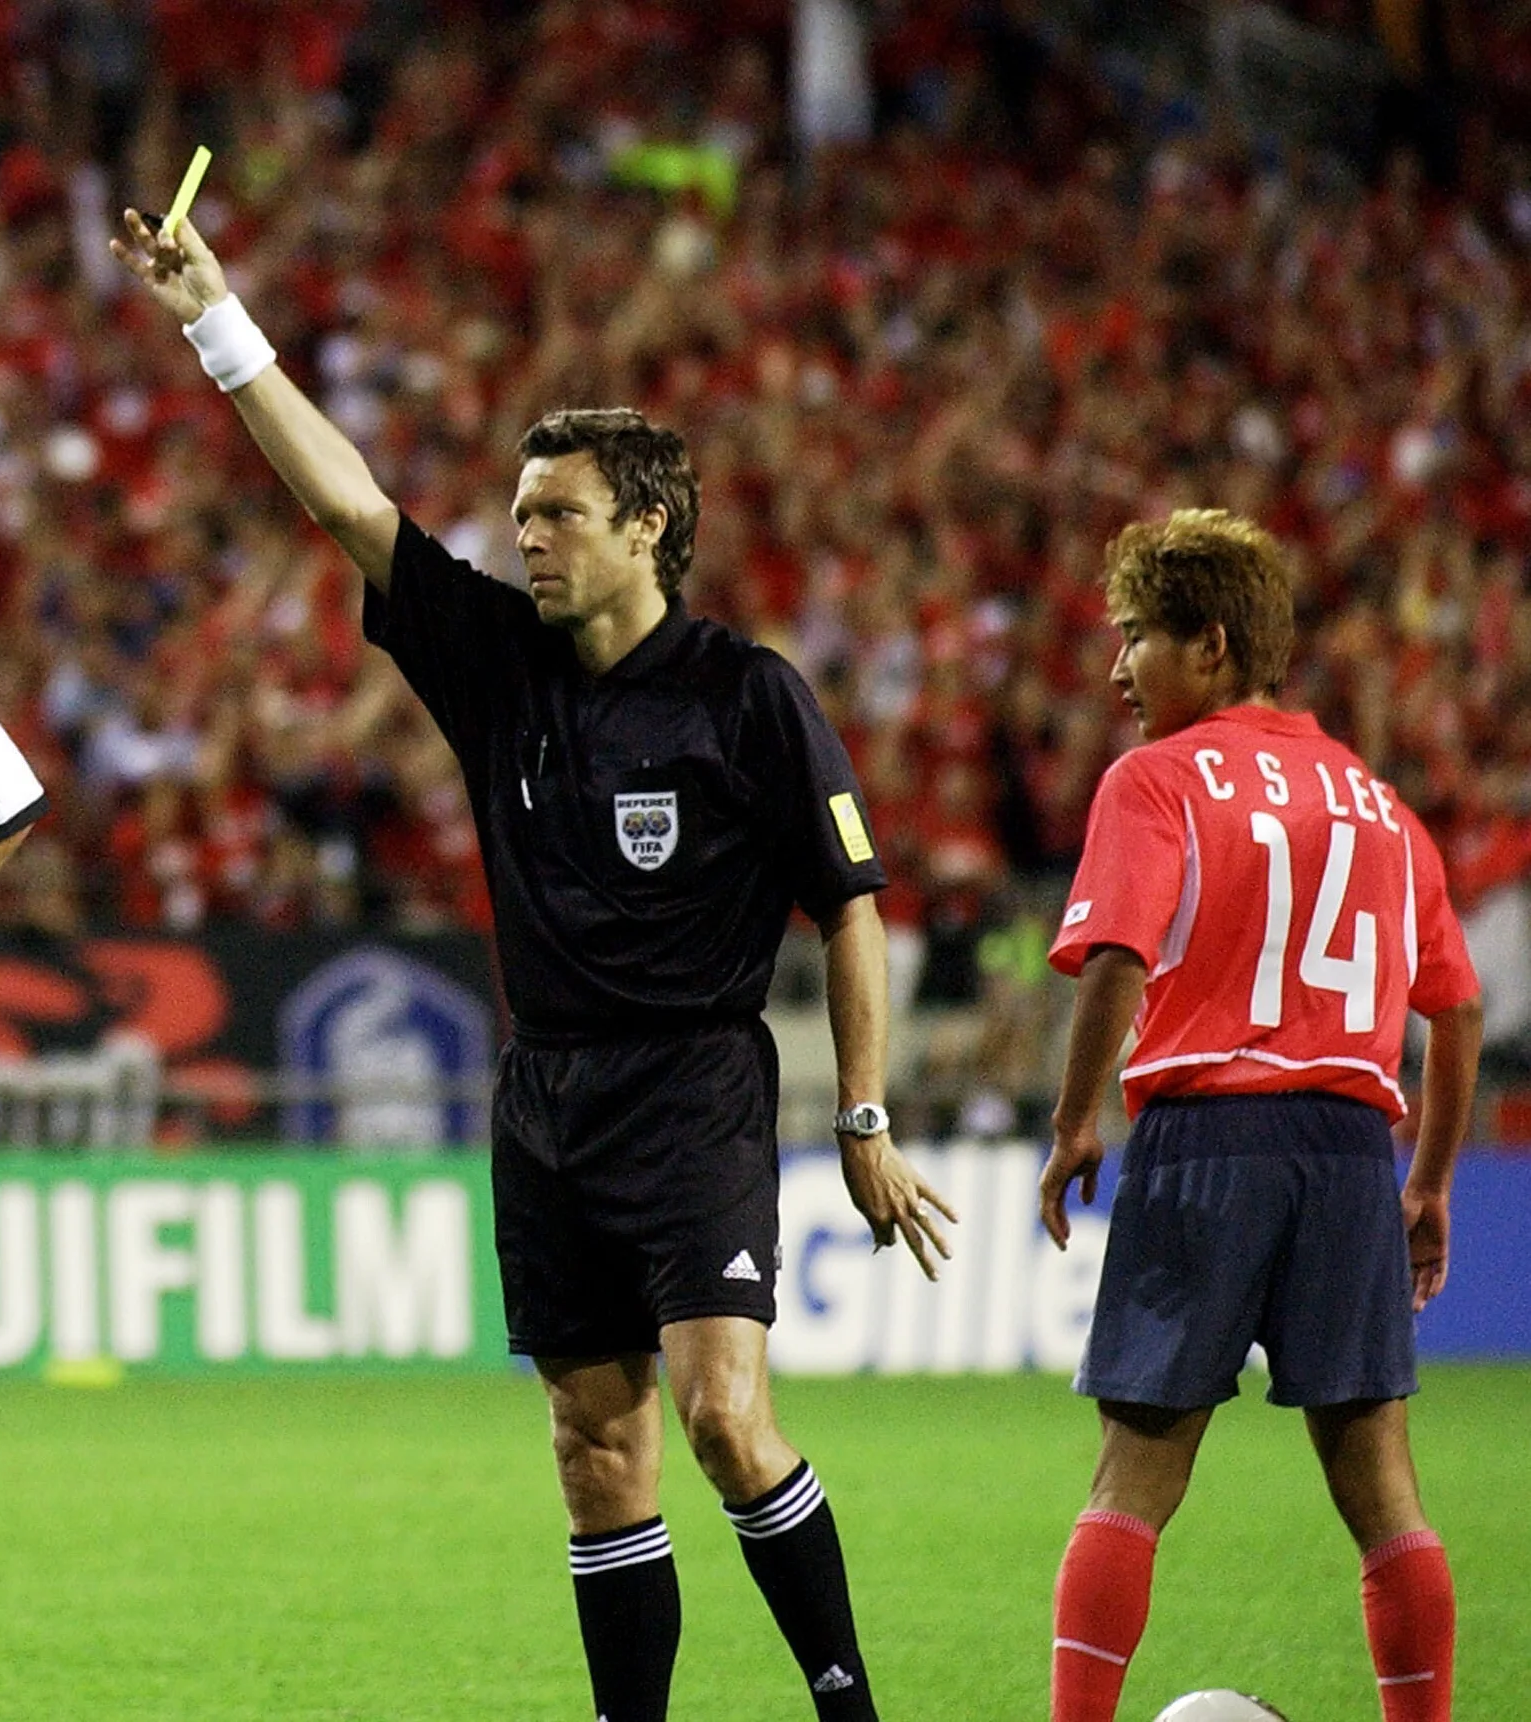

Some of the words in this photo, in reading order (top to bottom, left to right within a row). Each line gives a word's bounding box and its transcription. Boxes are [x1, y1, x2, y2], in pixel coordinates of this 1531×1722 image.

[1193, 749, 1235, 800] C
[1255, 751, 1290, 806] S
[1315, 762, 1400, 833] LEE
[631, 841, 664, 855] FIFA
[1247, 811, 1377, 1034] 14
